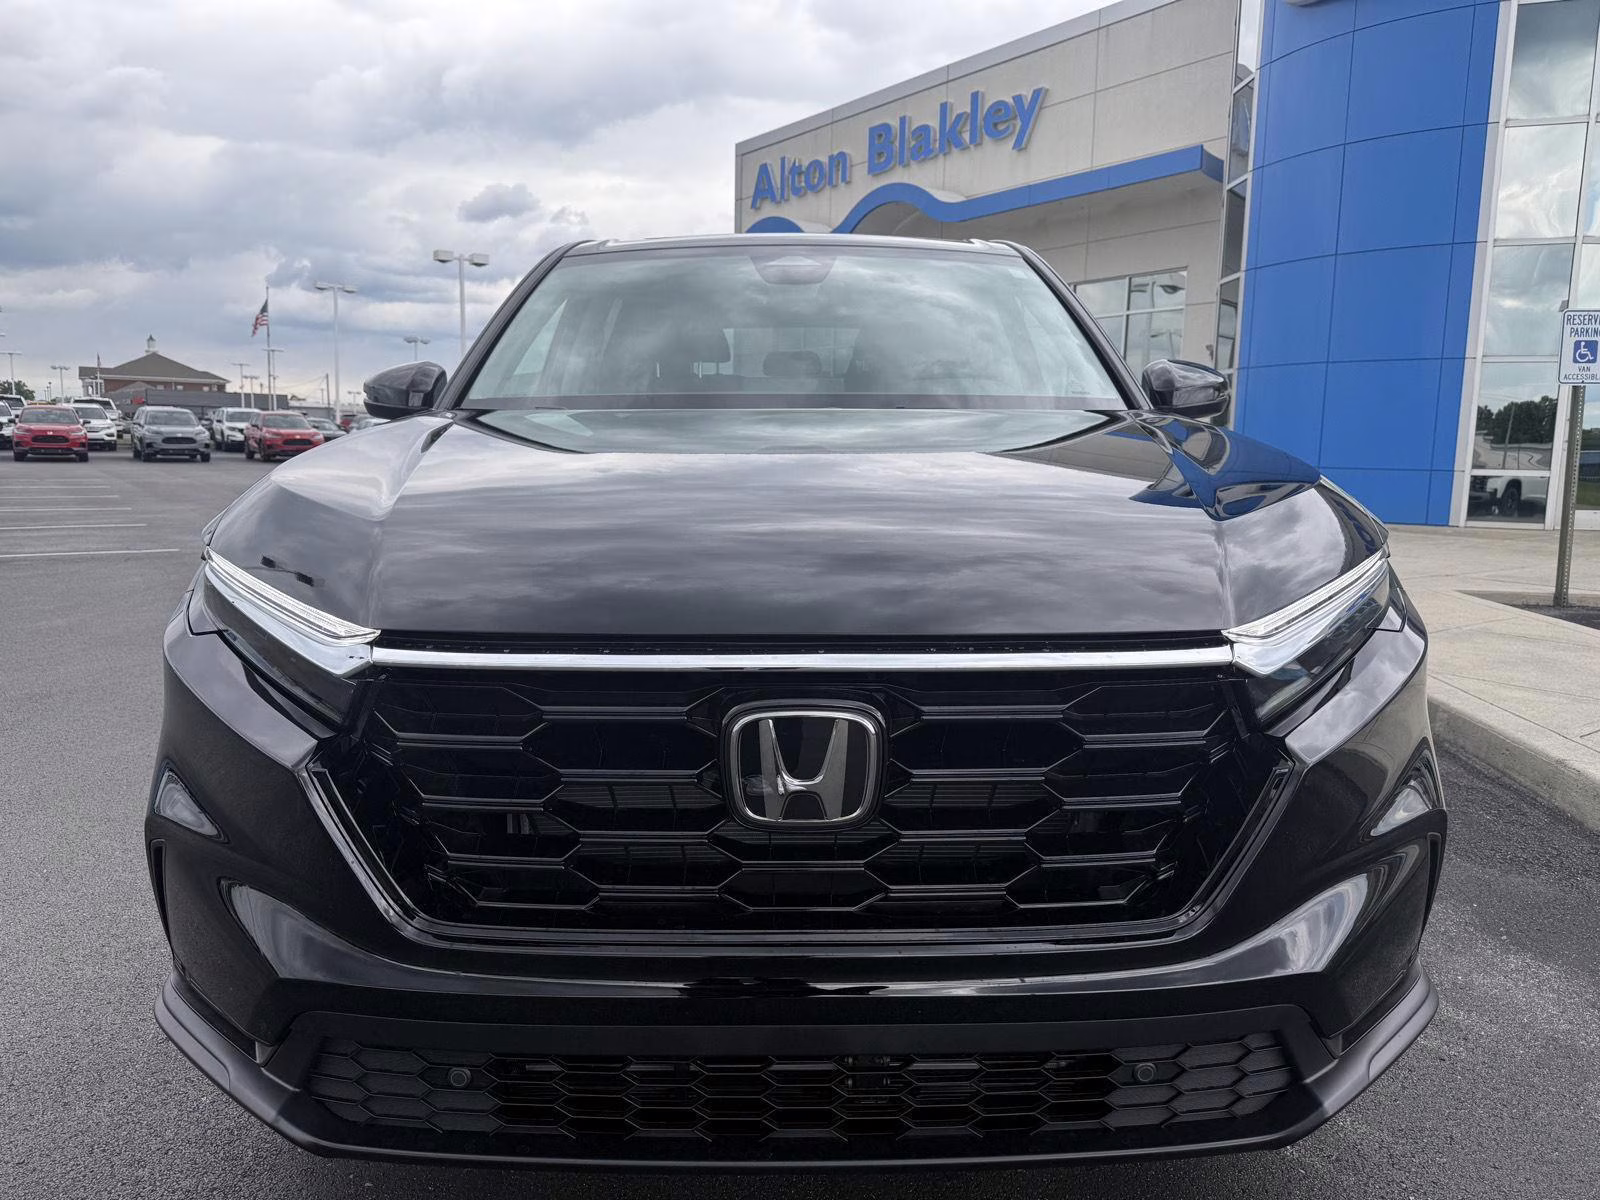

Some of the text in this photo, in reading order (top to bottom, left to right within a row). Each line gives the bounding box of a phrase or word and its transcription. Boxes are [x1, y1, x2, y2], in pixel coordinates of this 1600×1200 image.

[750, 86, 1048, 210] Alton Blakley
[1566, 314, 1600, 326] RESERV
[1569, 327, 1600, 338] PARKIN
[1578, 365, 1591, 373] VAN
[1563, 373, 1600, 381] ACCESSIBL
